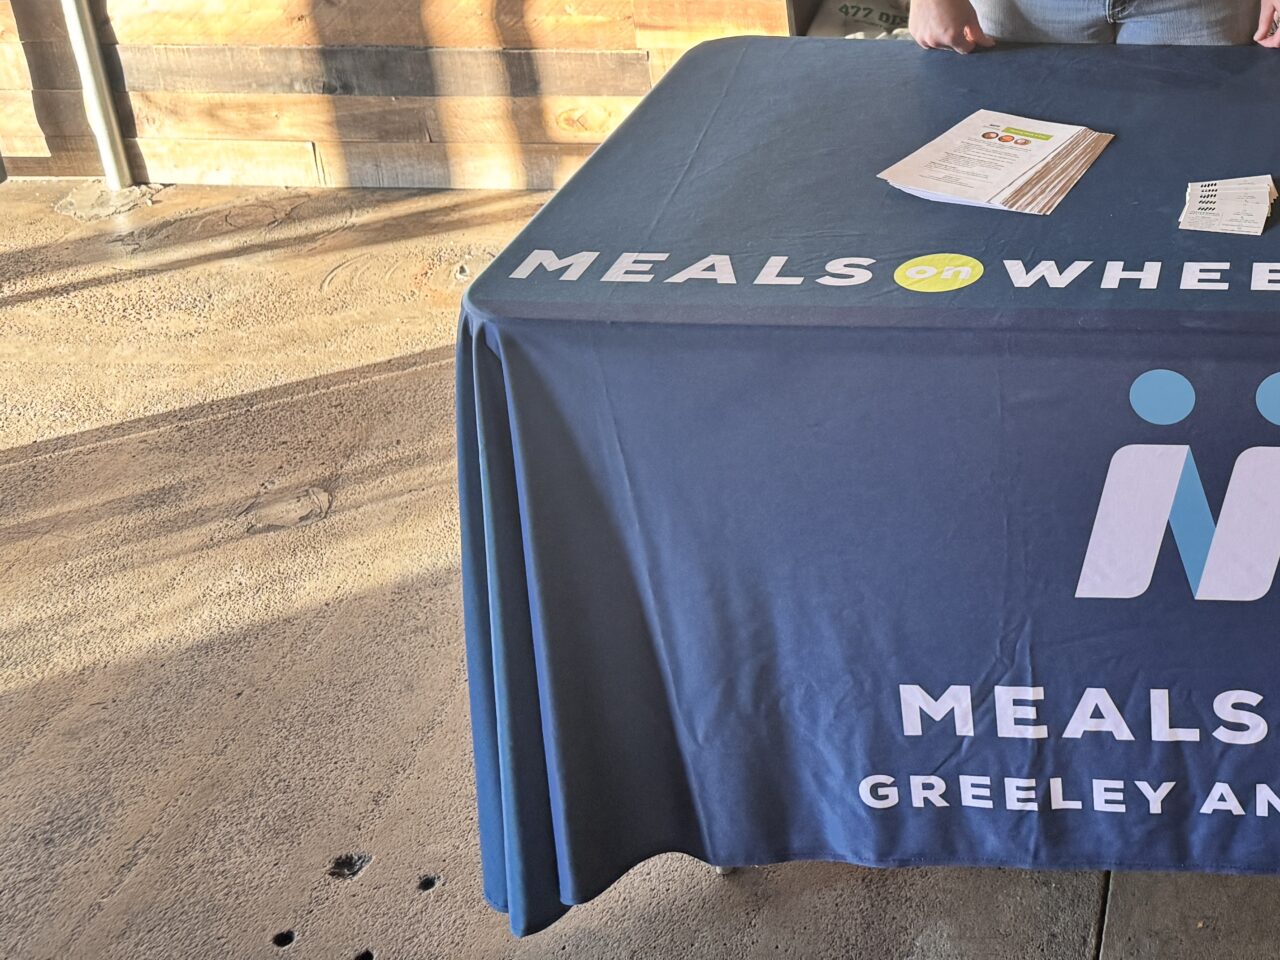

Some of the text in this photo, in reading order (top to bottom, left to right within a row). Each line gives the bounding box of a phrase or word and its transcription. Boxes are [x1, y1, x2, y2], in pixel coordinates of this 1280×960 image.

[839, 3, 874, 18] 477
[508, 249, 877, 287] MEALS
[904, 264, 974, 281] on
[898, 684, 1269, 745] MEALS
[858, 774, 1177, 815] GREELEY
